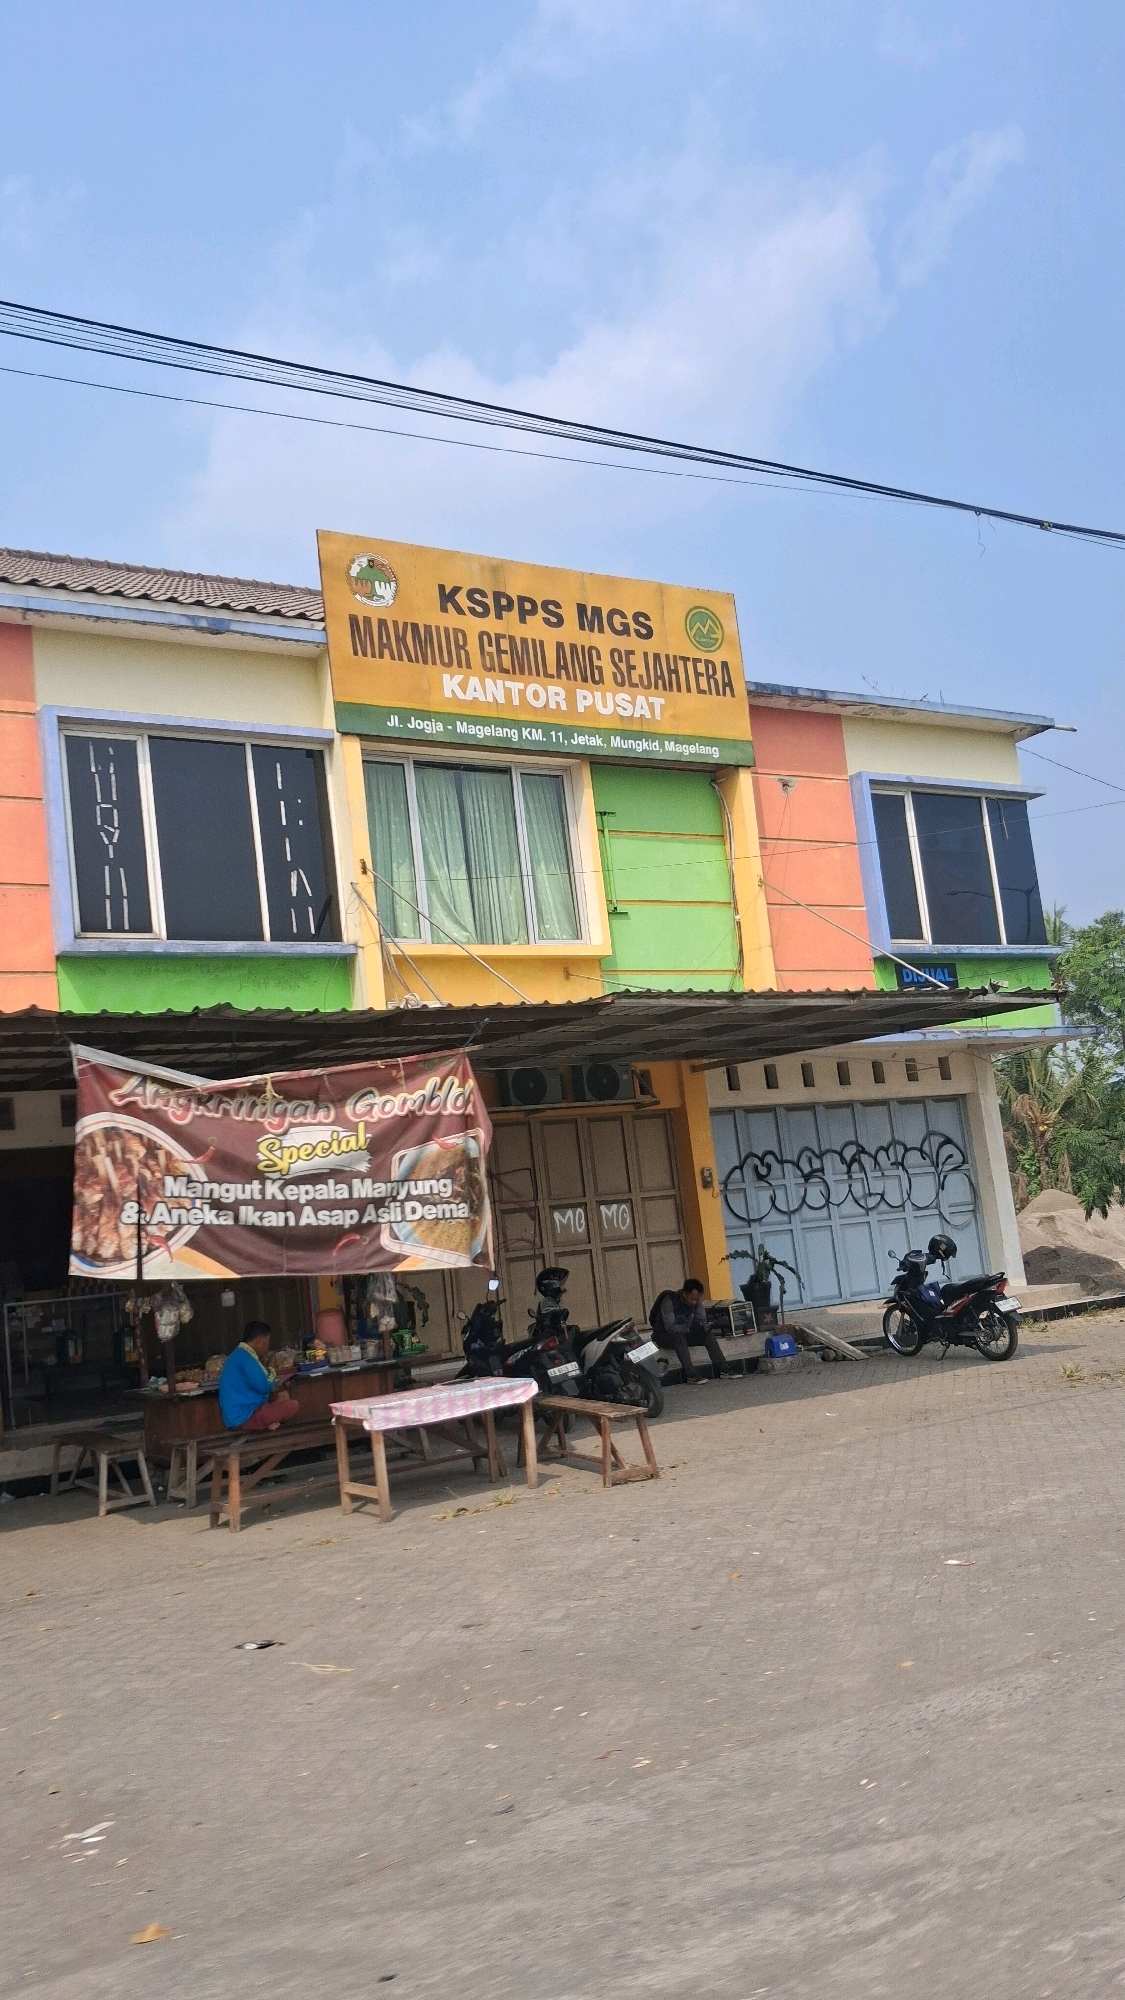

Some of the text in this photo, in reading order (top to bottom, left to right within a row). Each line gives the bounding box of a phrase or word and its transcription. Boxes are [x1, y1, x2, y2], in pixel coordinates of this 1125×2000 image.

[437, 583, 654, 640] KSPPS MGS
[348, 613, 736, 698] MAKMUR GEMILANG SEJAHTERA
[442, 673, 665, 721] KANTOR PUSAT
[386, 714, 404, 728] Jl.
[406, 716, 444, 734] Jogja
[456, 720, 519, 742] Magelang
[521, 727, 547, 742] KM.
[549, 730, 568, 746] 11,
[570, 732, 607, 749] Jetak,
[610, 735, 663, 753] Mungkid,
[664, 740, 720, 759] Magelang
[902, 967, 954, 983] DIJUAL
[256, 1121, 371, 1175] Special
[163, 1175, 453, 1204] Mangut Kepala Manyung
[151, 1200, 235, 1226] Aneka
[238, 1205, 296, 1227] Ikan
[298, 1204, 361, 1229] Asap
[360, 1200, 403, 1224] Asli
[404, 1200, 470, 1222] Dema
